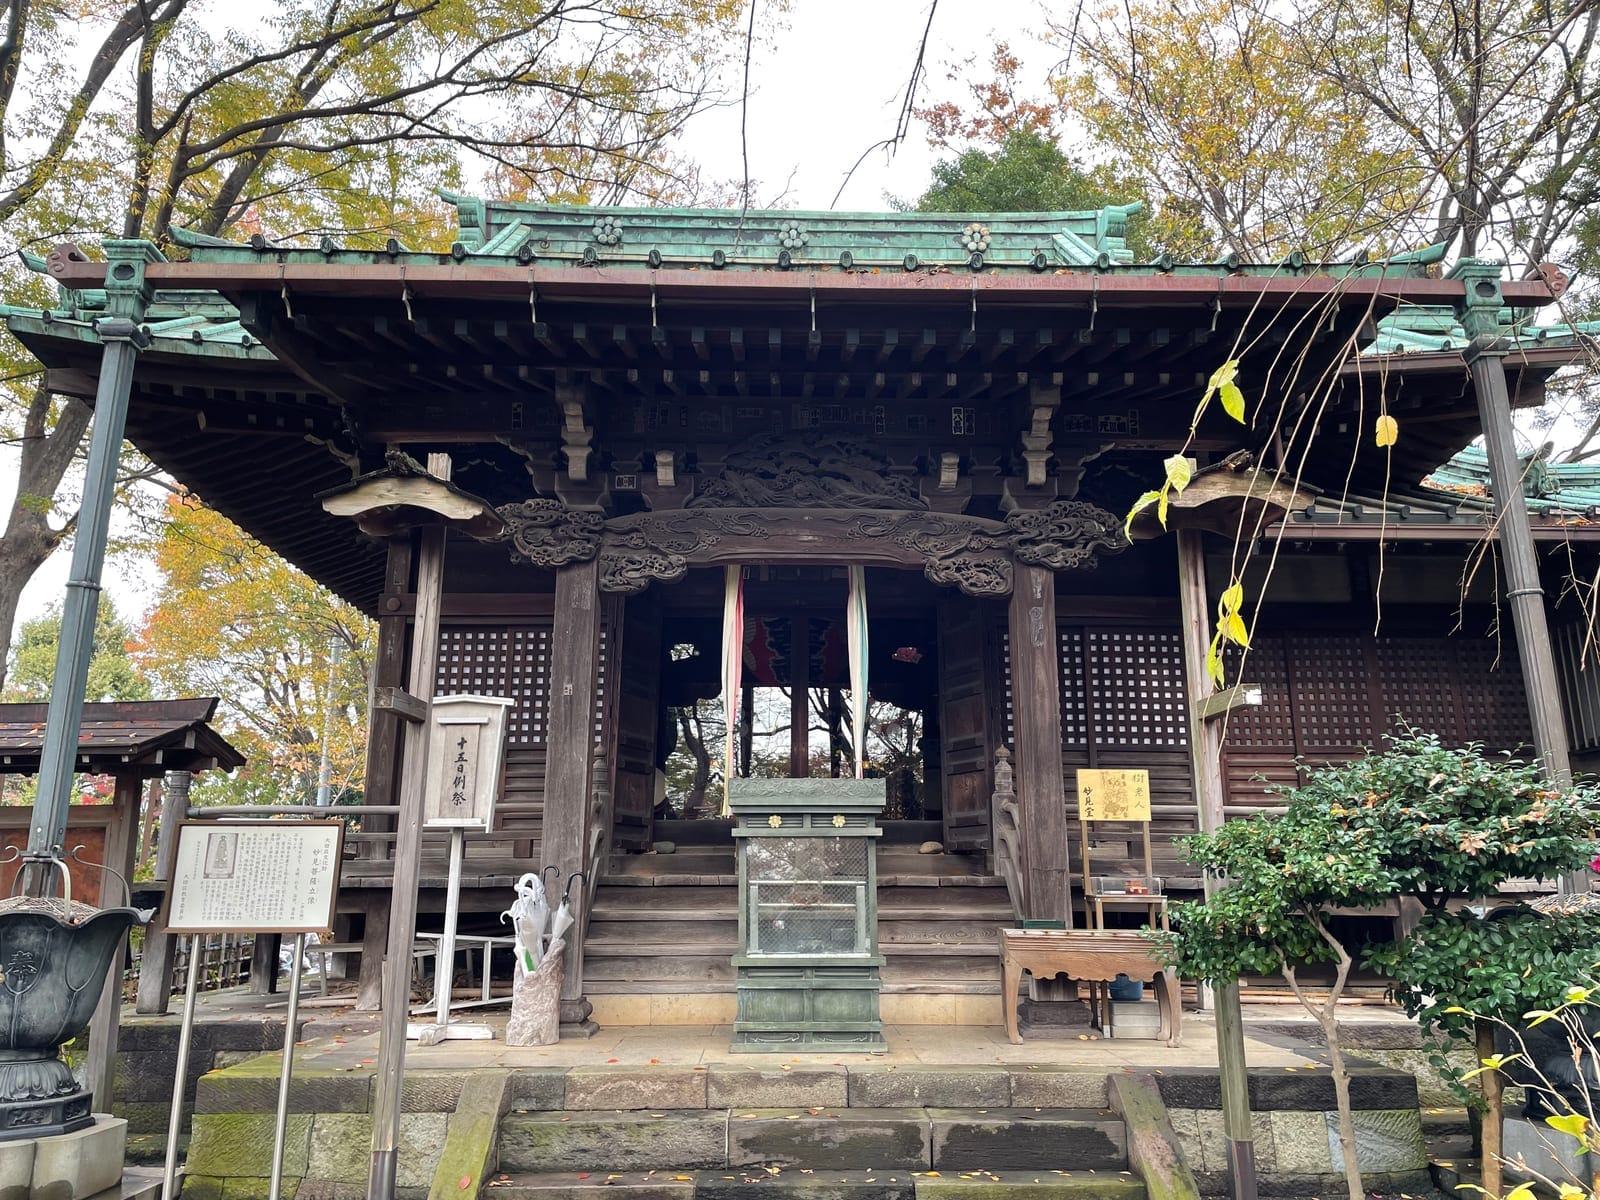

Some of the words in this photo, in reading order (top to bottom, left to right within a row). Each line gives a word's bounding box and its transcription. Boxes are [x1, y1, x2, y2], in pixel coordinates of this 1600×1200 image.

[452, 737, 468, 806] 十五日例祭
[1083, 786, 1095, 818] 妙見堂
[307, 848, 320, 905] 妙見菩薩立像
